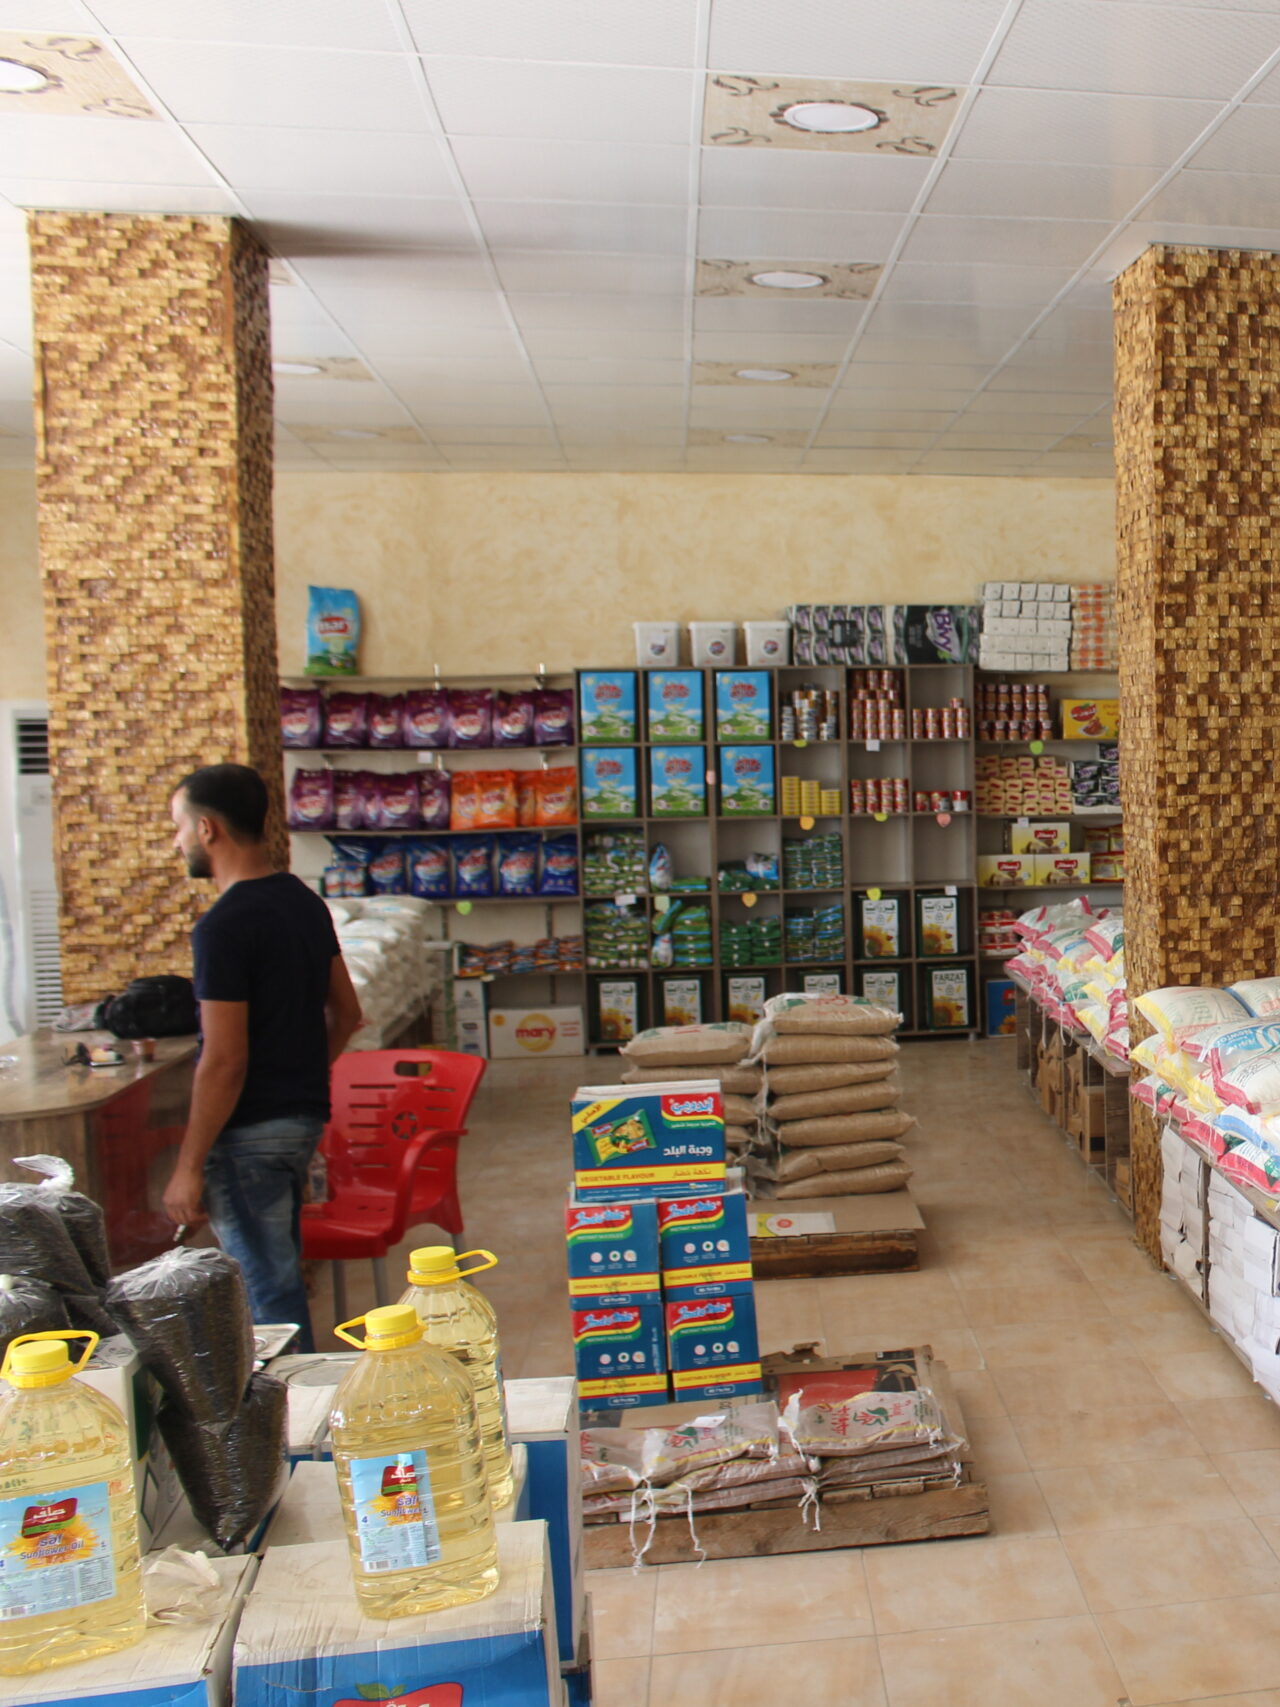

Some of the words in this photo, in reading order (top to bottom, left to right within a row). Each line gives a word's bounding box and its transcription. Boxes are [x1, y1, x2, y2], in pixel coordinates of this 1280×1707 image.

[515, 1026, 557, 1041] mary
[663, 1145, 687, 1158] البلد
[688, 1145, 713, 1156] وجبة
[580, 1173, 621, 1183] VEGETABLE
[622, 1171, 656, 1181] FLAVOUR
[20, 1545, 70, 1560] Sunflower
[71, 1540, 85, 1550] Oil
